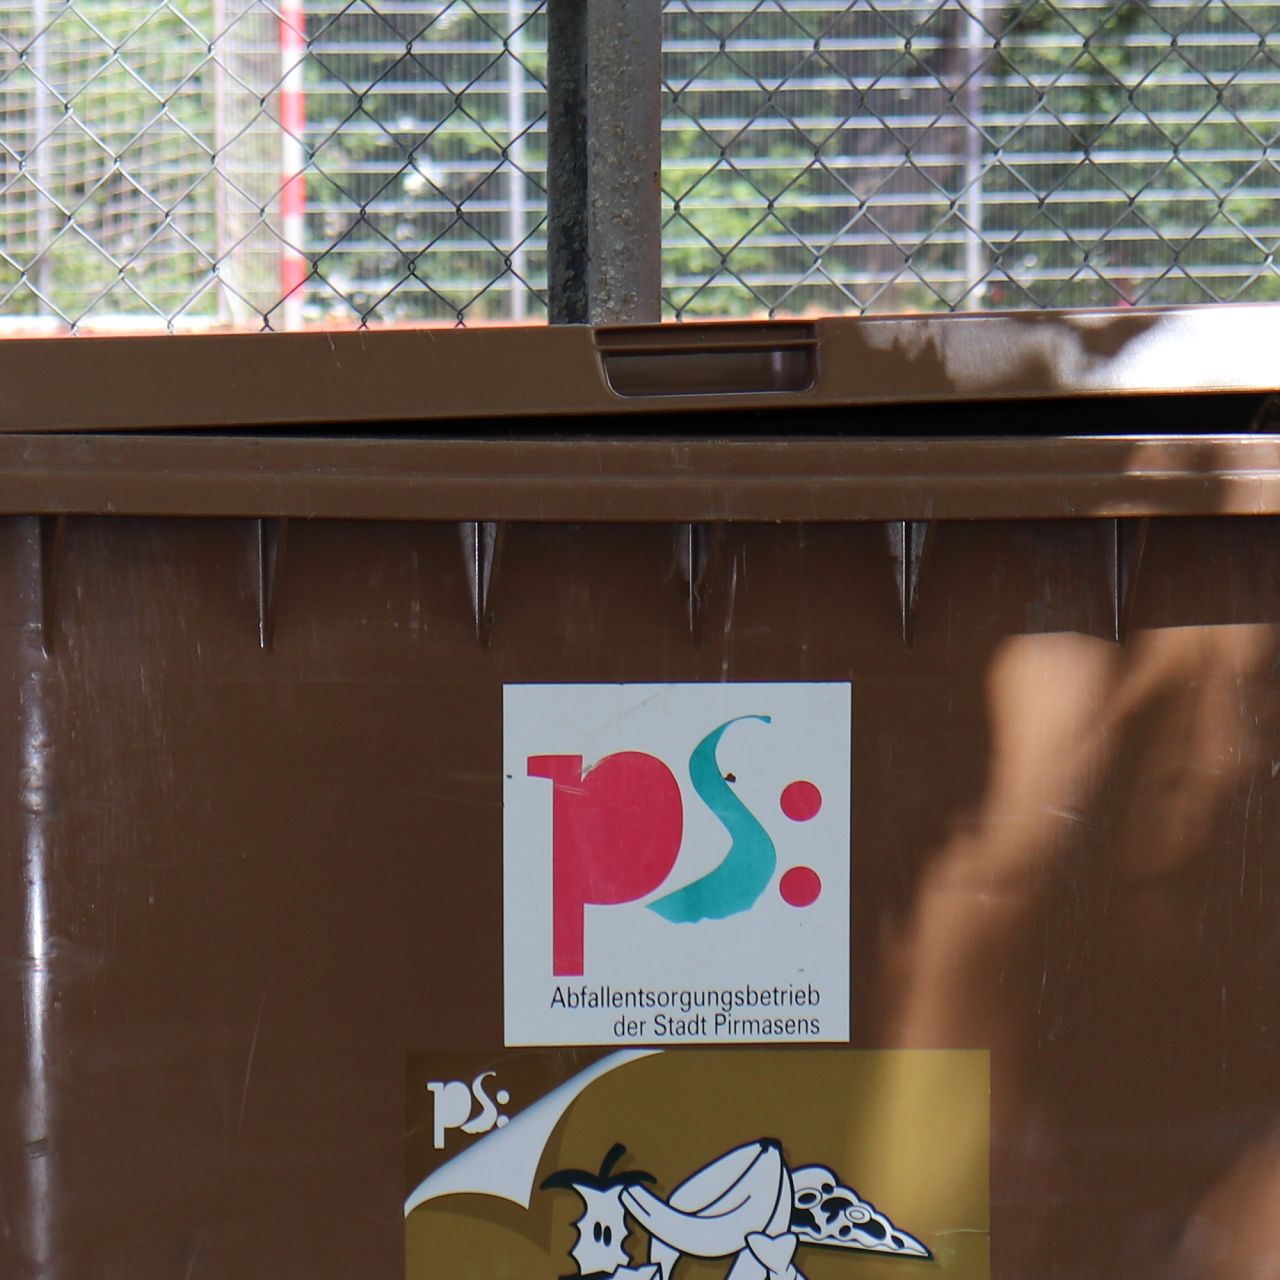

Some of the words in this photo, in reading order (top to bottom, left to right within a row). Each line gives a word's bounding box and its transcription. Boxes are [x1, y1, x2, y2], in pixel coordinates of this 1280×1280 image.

[550, 984, 821, 1012] Abfallentsorgungsbetrieb
[613, 1014, 646, 1037] der
[653, 1013, 708, 1037] Stadt
[714, 1013, 821, 1036] Pirmasens
